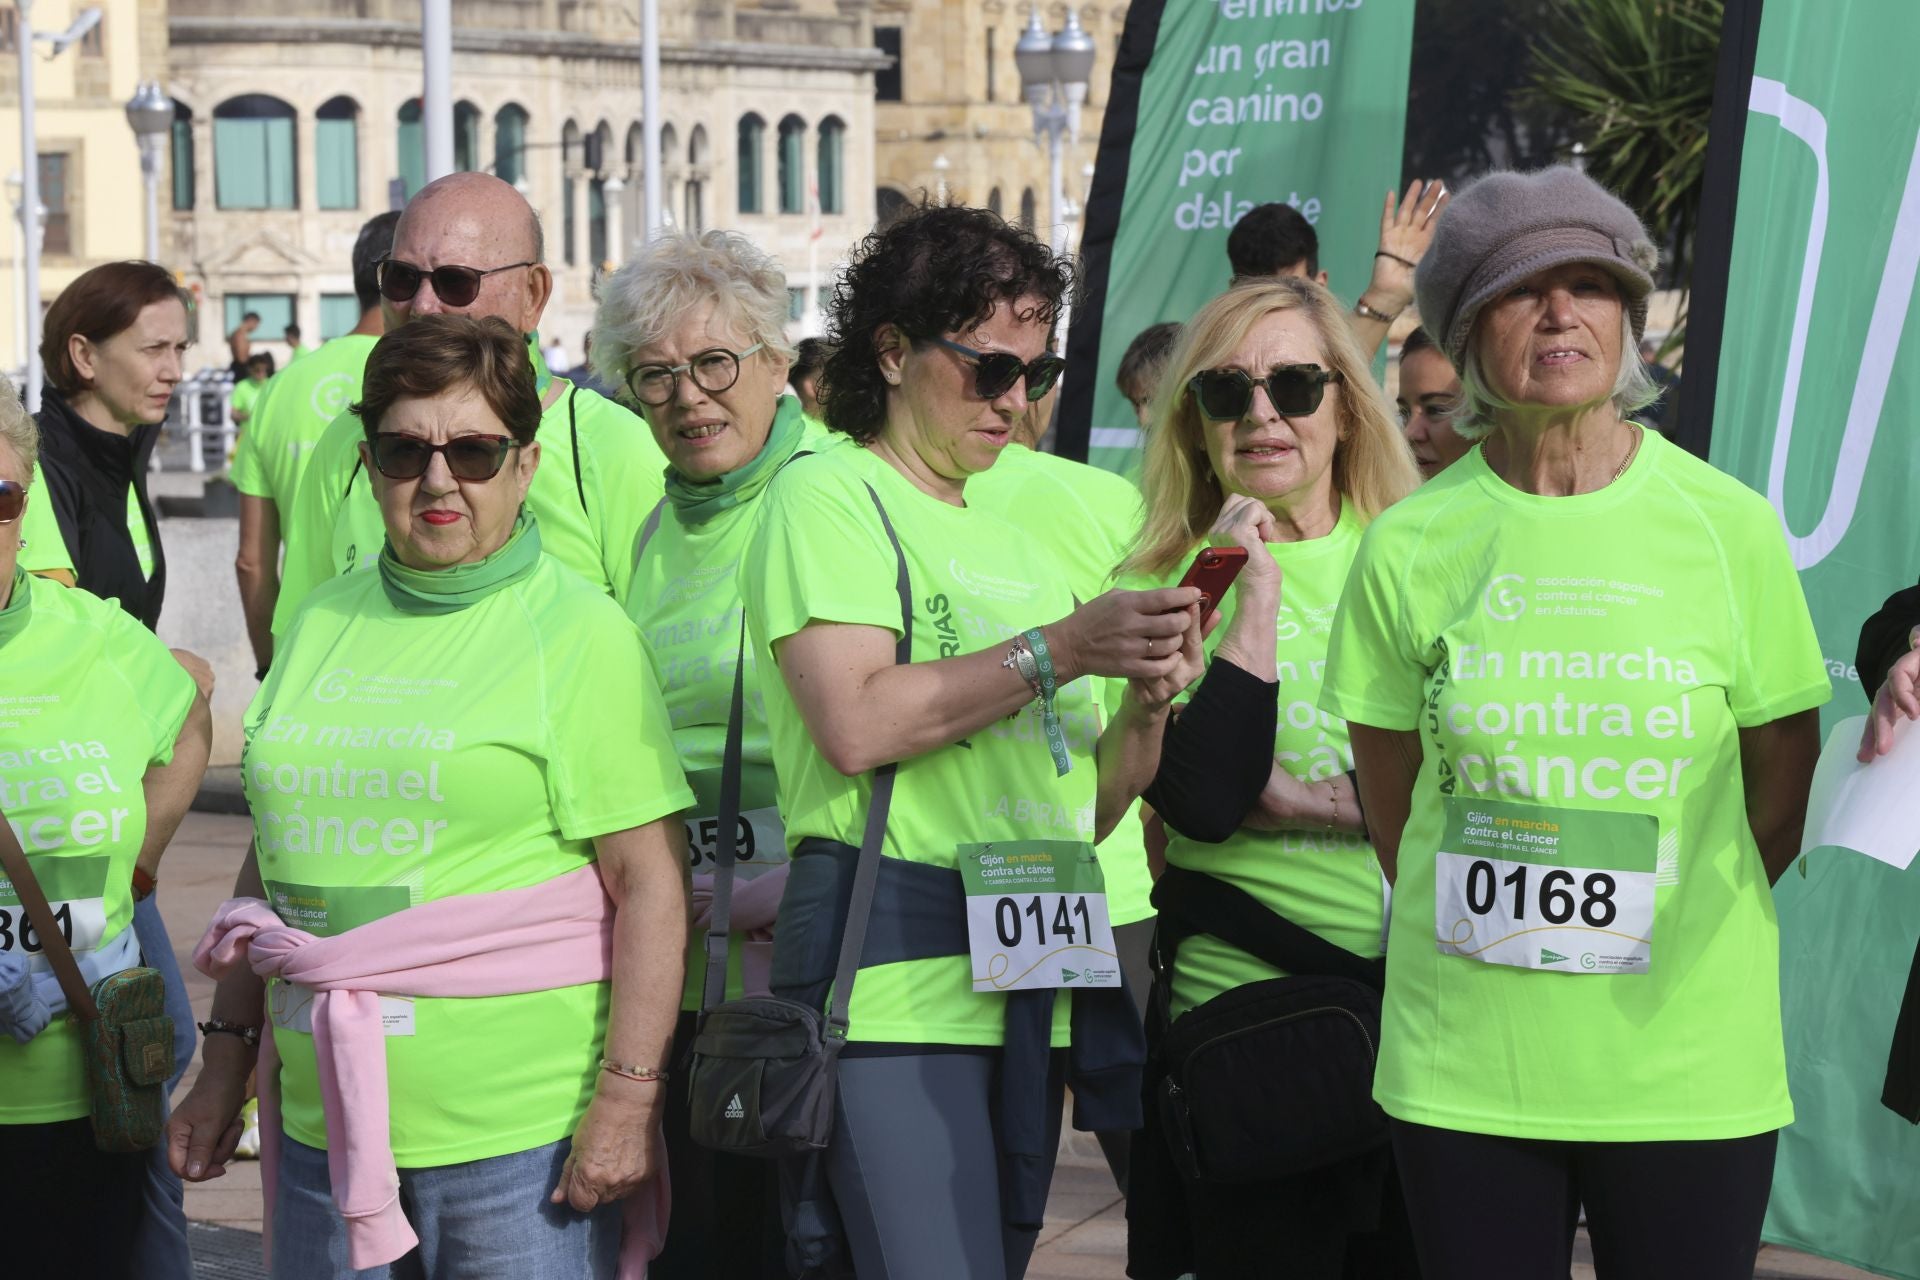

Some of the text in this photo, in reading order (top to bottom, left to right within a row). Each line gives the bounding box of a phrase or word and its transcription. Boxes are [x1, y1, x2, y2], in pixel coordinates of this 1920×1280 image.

[1254, 38, 1330, 79] gran
[1535, 576, 1664, 598] asociación española
[1535, 590, 1638, 606] contra el cáncer
[1535, 605, 1607, 617] en Asturias
[1453, 645, 1700, 686] En marcha
[1447, 692, 1696, 740] contra el
[262, 715, 457, 752] En marcha
[75, 764, 121, 795] el
[252, 758, 445, 803] contra el
[1457, 740, 1694, 800] cáncer
[8, 807, 129, 852] cer
[260, 800, 449, 857] cáncer
[1463, 826, 1560, 846] contra el cáncer
[1466, 811, 1559, 832] Gijón en marcha
[980, 854, 1005, 867] Gijón
[1496, 842, 1520, 851] CONTRA
[981, 863, 1055, 877] contra el cáncer
[1466, 859, 1617, 928] 0168
[995, 895, 1092, 948] 0141
[725, 1110, 744, 1119] adidas
